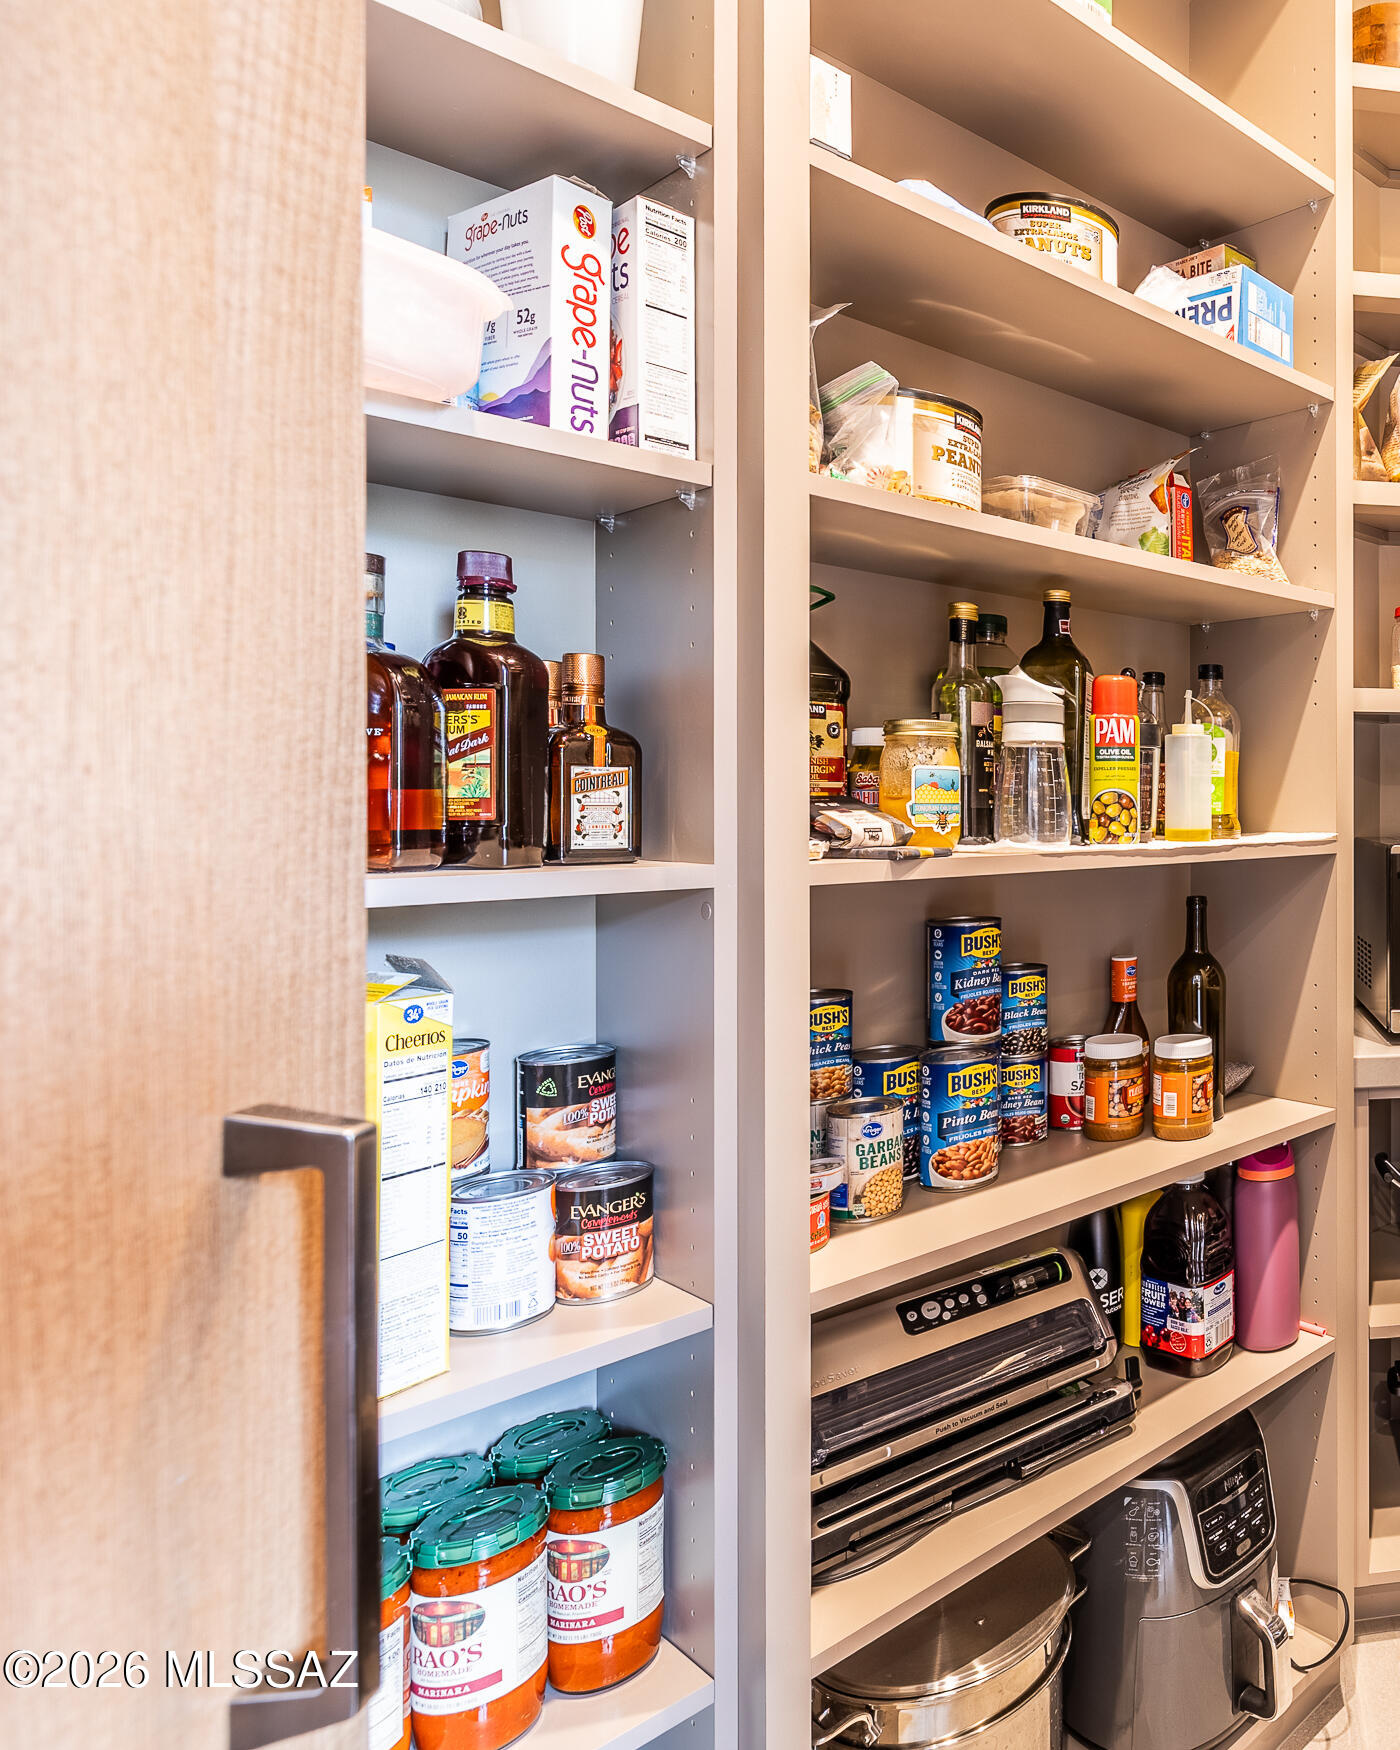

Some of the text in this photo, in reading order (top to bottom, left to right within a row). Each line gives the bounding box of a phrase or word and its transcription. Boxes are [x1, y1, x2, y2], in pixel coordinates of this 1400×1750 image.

[645, 204, 670, 219] Nutrition
[671, 215, 687, 226] Facts
[1022, 204, 1071, 217] KIRKLAND
[464, 208, 529, 252] grape-nuts
[1030, 220, 1062, 229] SUPER
[645, 228, 688, 248] Calories 200
[1014, 228, 1079, 241] EXTRA-LARGE
[1022, 237, 1091, 261] ANUTS
[1190, 259, 1212, 277] BITE
[516, 307, 536, 325] 52g
[561, 244, 606, 434] grape-nuts
[963, 435, 980, 449] SUPE
[931, 444, 981, 477] PEANU
[447, 714, 479, 725] ERS'S
[449, 725, 465, 734] UM
[1095, 718, 1135, 745] PAM
[460, 732, 490, 752] Dark
[810, 765, 836, 774] IRGIN
[574, 772, 625, 793] COINTREAU
[973, 968, 990, 976] DARK
[954, 973, 991, 990] Kidney
[1010, 979, 1046, 995] BUSH'S
[960, 991, 982, 1000] FRIJOLES
[1004, 1007, 1047, 1021] Black Bean
[385, 1029, 446, 1052] Cheerios
[810, 1042, 851, 1056] hick Peas
[383, 1058, 404, 1068] Datos
[577, 1066, 616, 1088] EVANG
[951, 1068, 997, 1094] BUSH'S
[1001, 1067, 1039, 1084] BUSH'S
[420, 1085, 432, 1095] 140
[435, 1082, 447, 1092] 210
[971, 1088, 986, 1096] BEST
[590, 1092, 616, 1112] SWEE
[1001, 1098, 1044, 1109] idney Beans
[563, 1104, 616, 1125] 100% POTA
[942, 1109, 998, 1129] Pinto Bean
[862, 1125, 882, 1136] Kroger
[949, 1130, 982, 1142] FRIJOLES
[855, 1133, 903, 1157] GARBAN
[860, 1148, 902, 1171] BEANS
[570, 1192, 646, 1220] EVANGER'S
[581, 1210, 638, 1230] Complements
[457, 1232, 468, 1240] 50
[583, 1223, 639, 1247] SWEET
[560, 1235, 640, 1260] 100% POTATO
[935, 1400, 1009, 1435] Push to Vacuum and Seal
[547, 1580, 607, 1603] RAO'S
[549, 1601, 598, 1611] HOMEMADE
[550, 1618, 596, 1629] MARINARA
[413, 1642, 483, 1669] RAO'S
[416, 1667, 473, 1677] HOMEMADE
[417, 1685, 472, 1697] MARINARA
